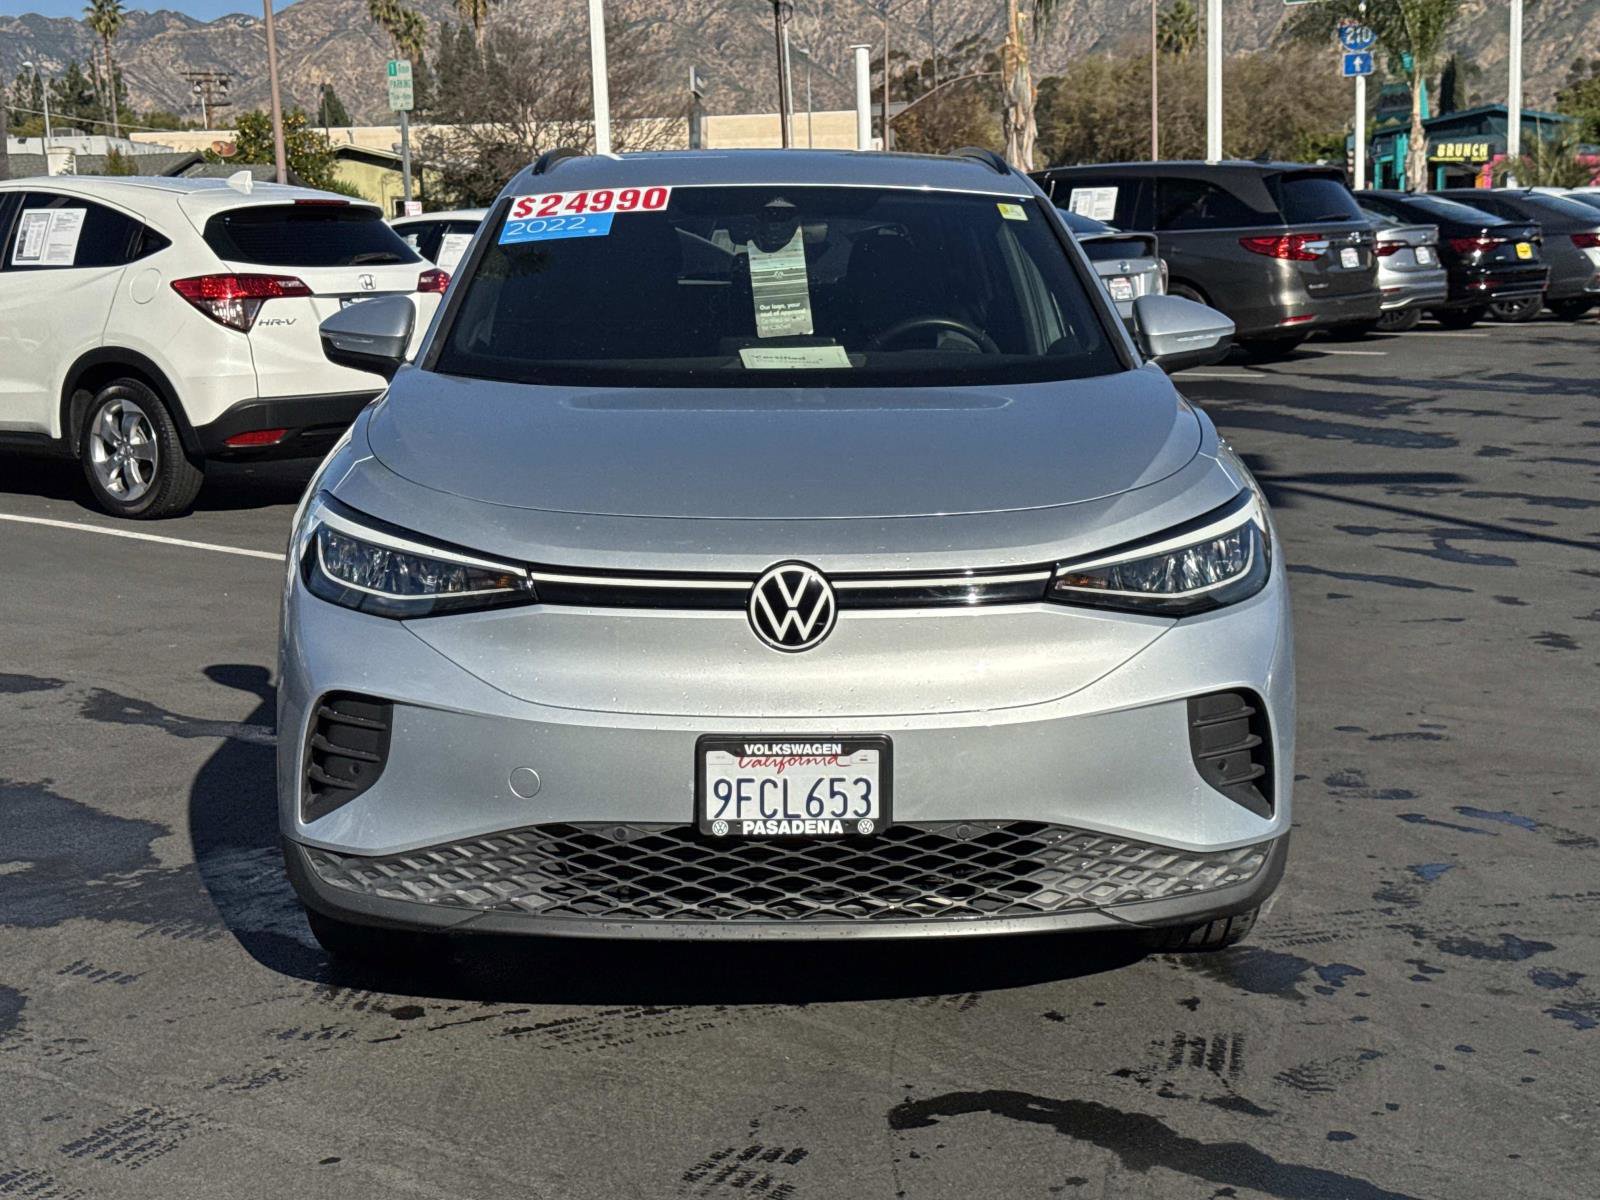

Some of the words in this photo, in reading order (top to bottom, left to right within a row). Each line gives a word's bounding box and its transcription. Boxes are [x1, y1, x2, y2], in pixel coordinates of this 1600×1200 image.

[1345, 27, 1371, 44] 210
[1437, 143, 1488, 157] BRUNCH
[512, 187, 668, 218] $24990
[258, 318, 296, 326] HR-V
[744, 743, 842, 755] VOLKSWAGEN
[713, 777, 872, 819] 9FCL653
[742, 820, 843, 834] PASADENA
